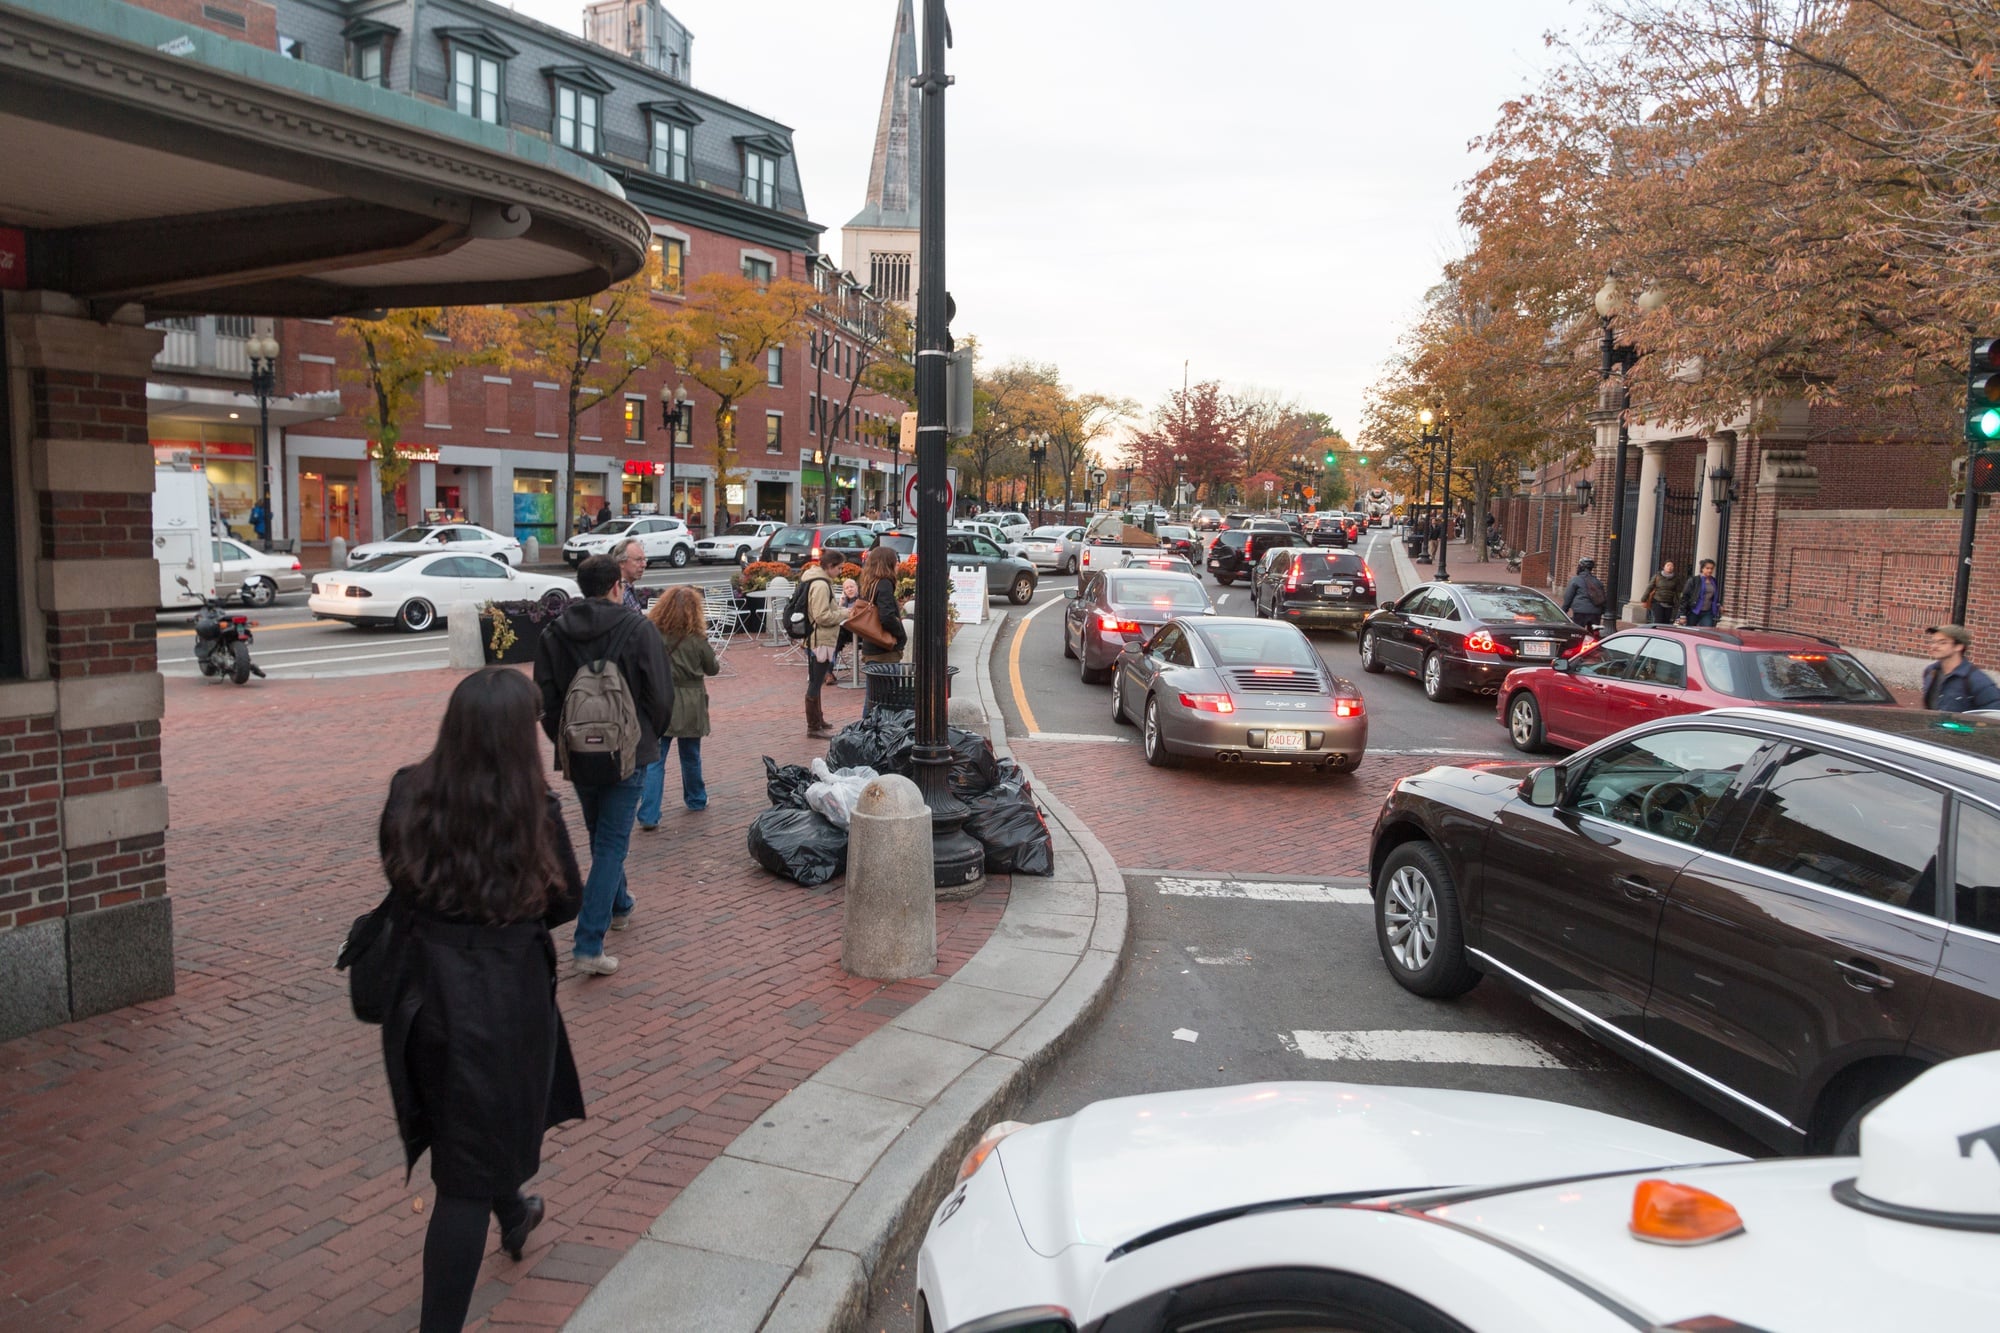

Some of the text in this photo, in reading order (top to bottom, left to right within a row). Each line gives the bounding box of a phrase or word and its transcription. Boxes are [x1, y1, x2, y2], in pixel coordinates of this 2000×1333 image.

[624, 459, 653, 475] CVS
[1094, 474, 1104, 483] T
[1265, 700, 1290, 708] Targa
[1269, 735, 1285, 745] 64D
